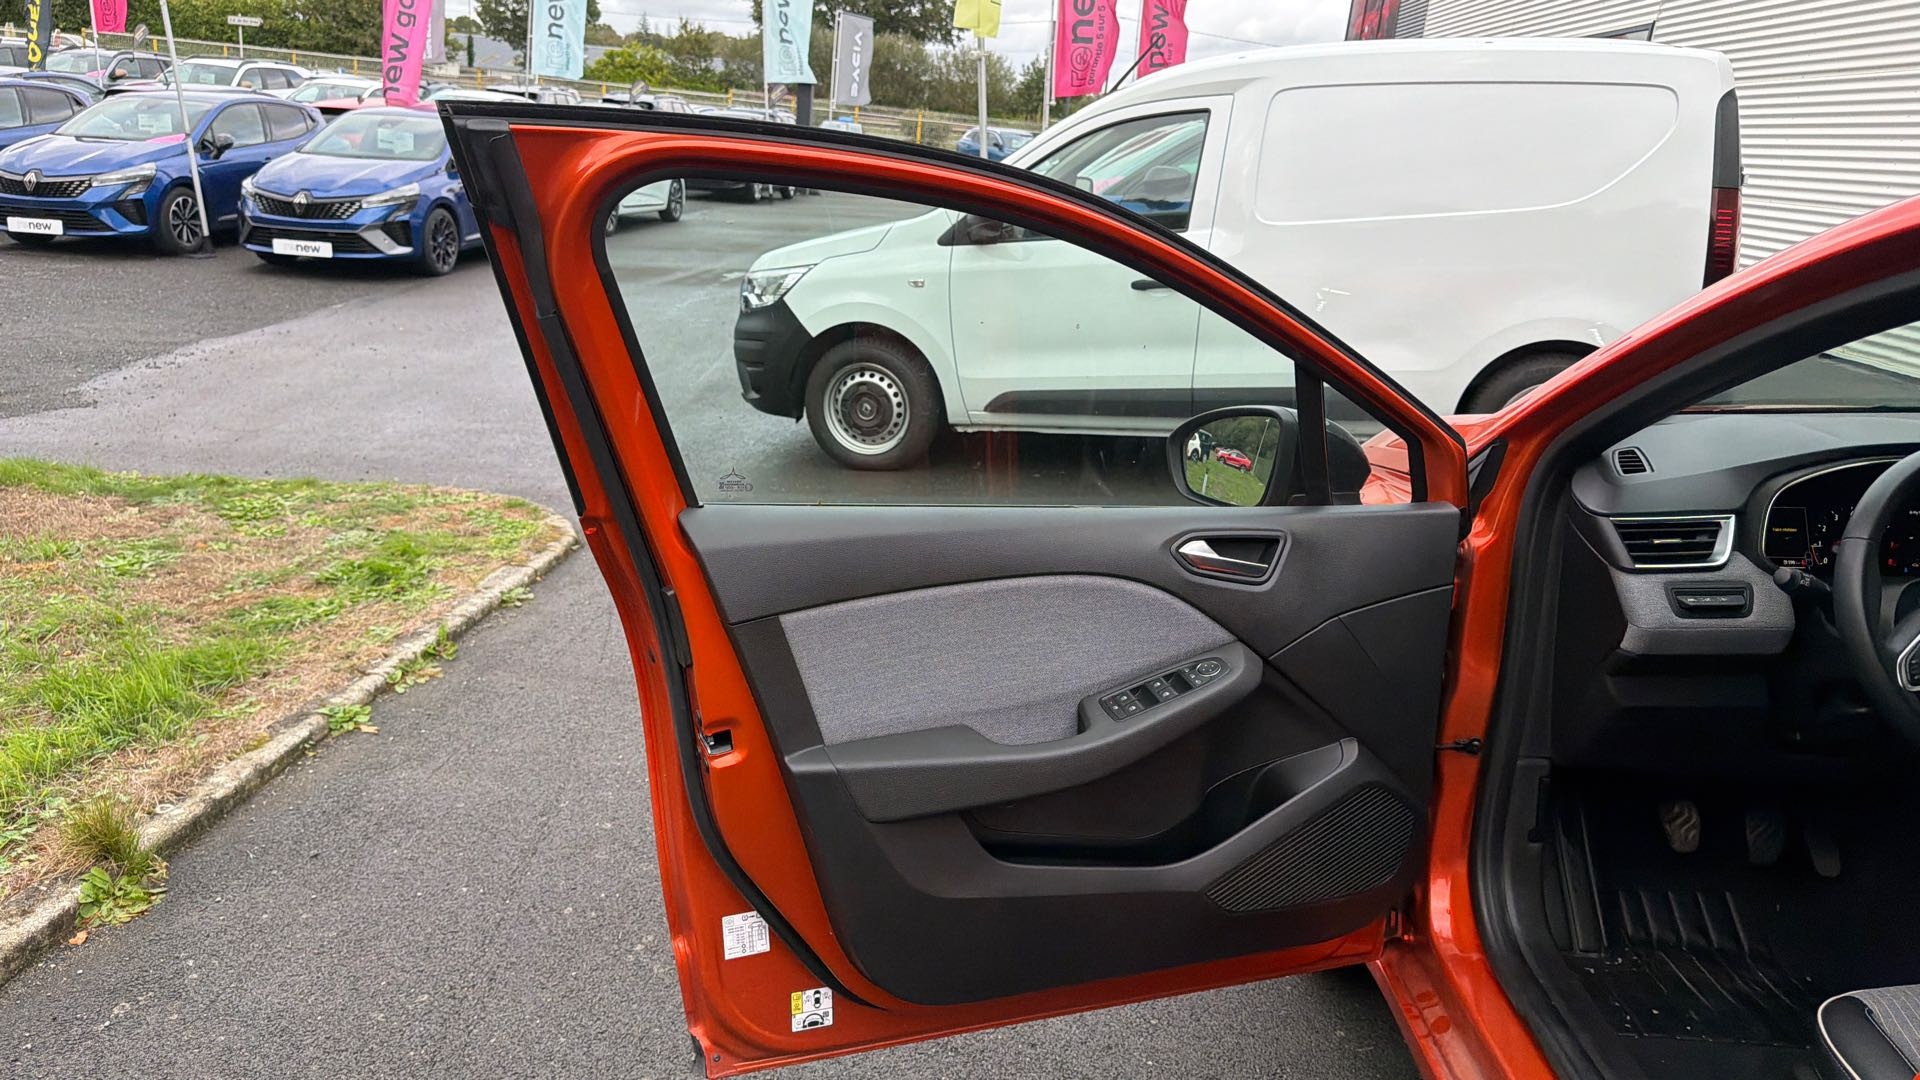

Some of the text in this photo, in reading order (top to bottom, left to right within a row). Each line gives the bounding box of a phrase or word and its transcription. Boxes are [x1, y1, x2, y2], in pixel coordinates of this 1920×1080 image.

[545, 0, 566, 70] rene
[850, 31, 863, 98] DACIA
[1087, 42, 1104, 86] garantie
[1097, 13, 1105, 32] sur
